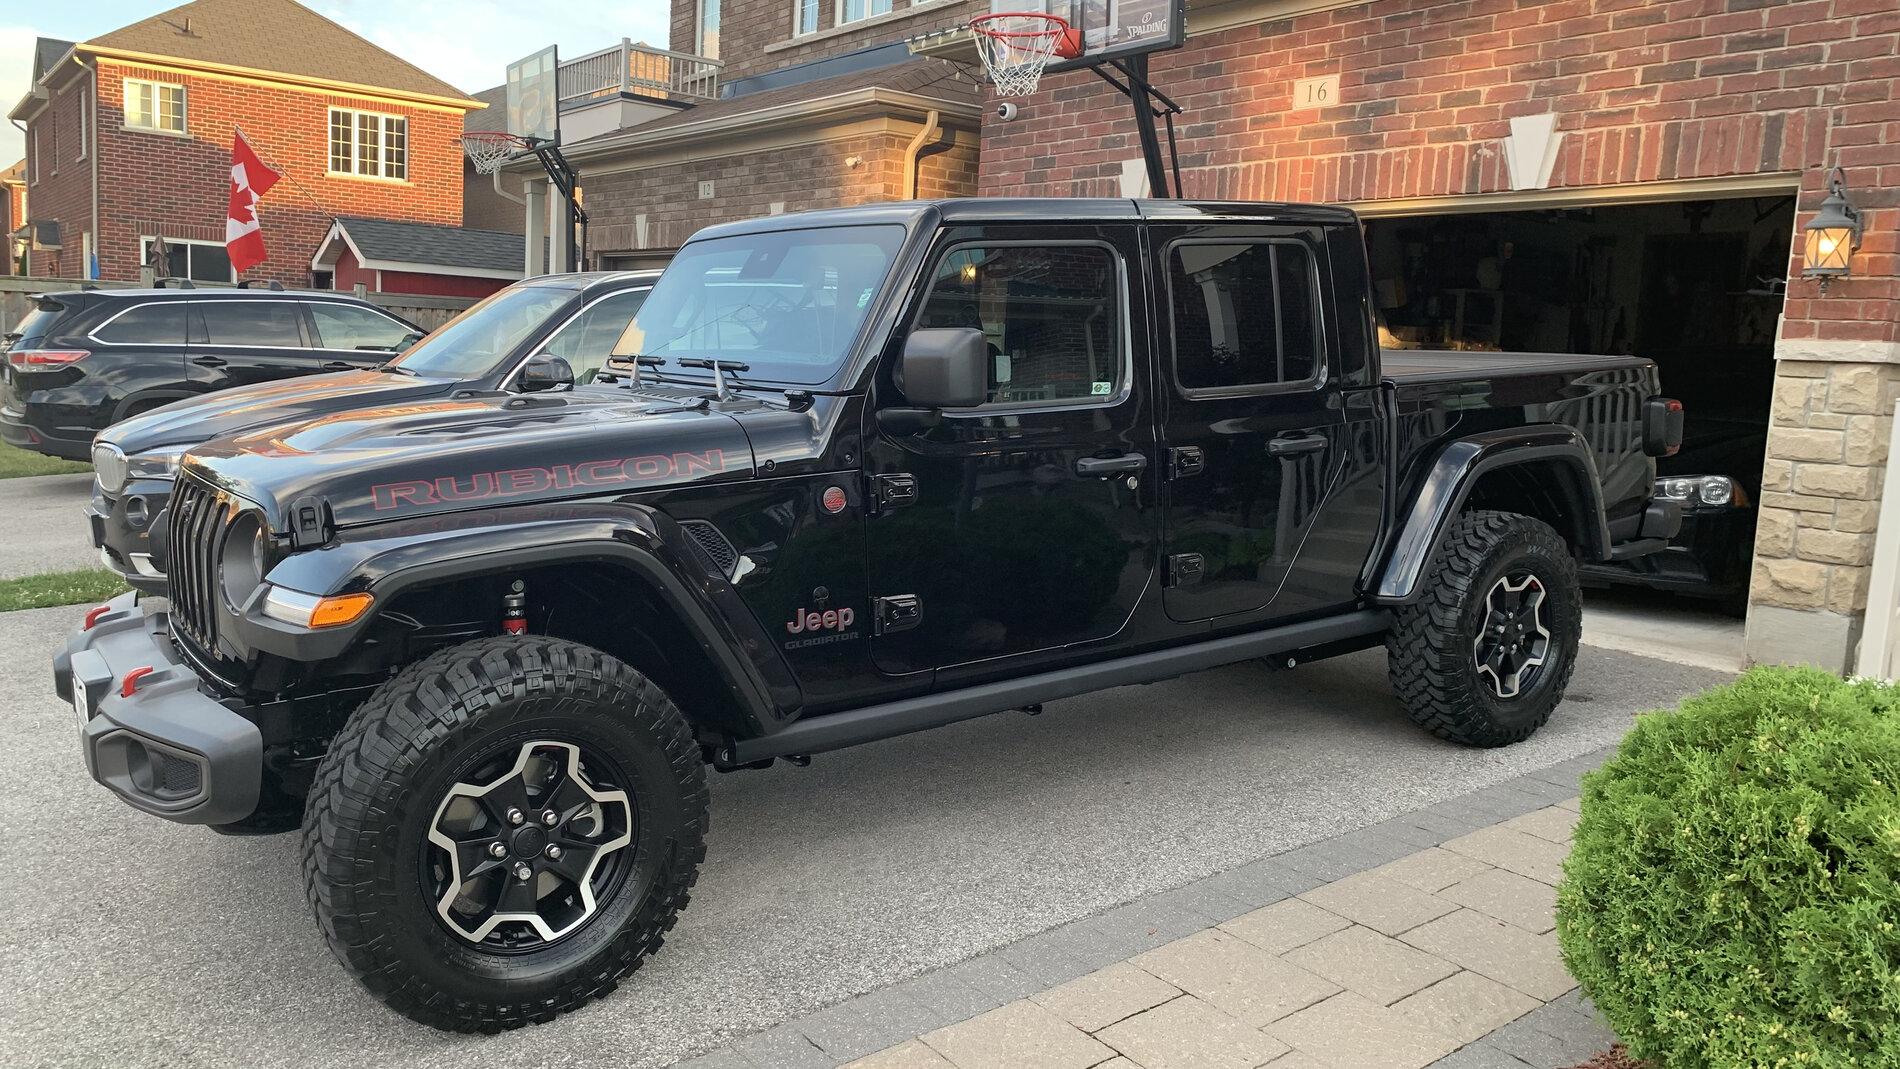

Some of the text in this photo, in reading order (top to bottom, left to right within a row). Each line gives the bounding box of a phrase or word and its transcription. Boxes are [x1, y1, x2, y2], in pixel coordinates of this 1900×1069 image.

[1127, 18, 1168, 39] SPALDING
[1308, 81, 1327, 102] 16
[703, 183, 711, 196] 12
[371, 449, 724, 511] RUBICON
[786, 607, 855, 634] Jeep
[784, 631, 860, 651] GLADIATOR
